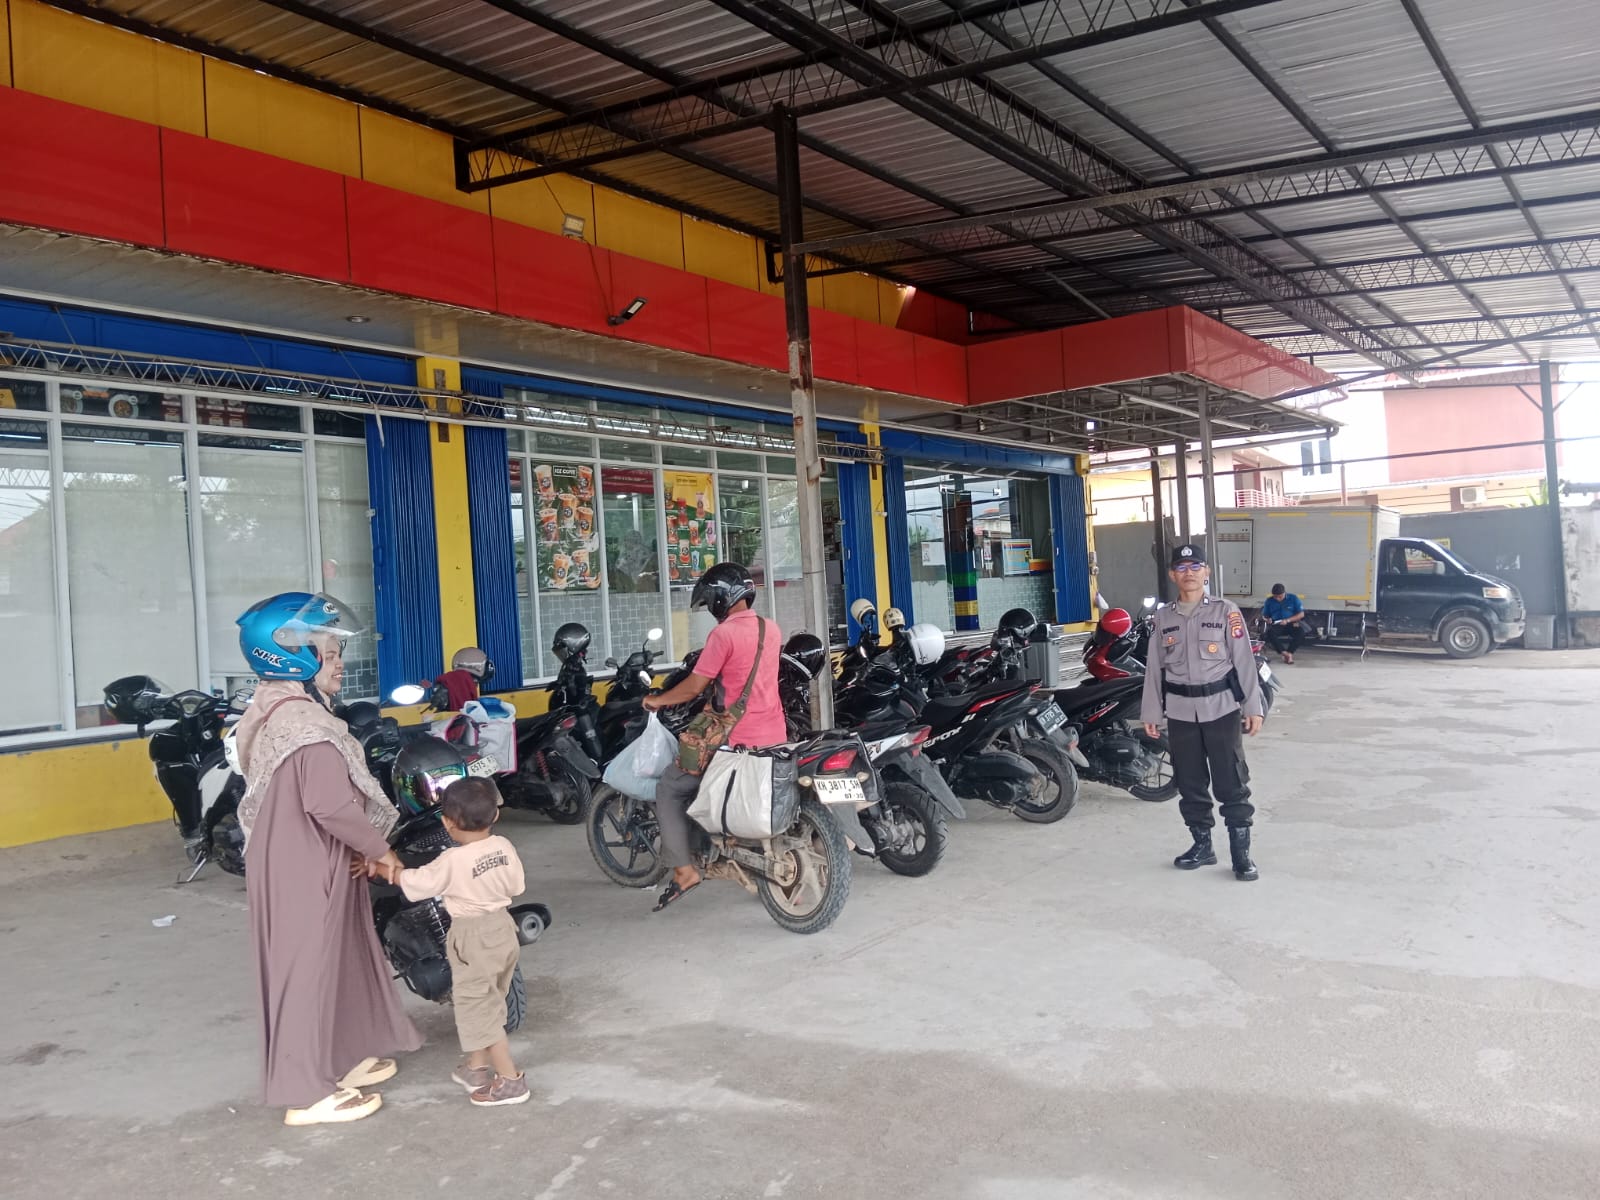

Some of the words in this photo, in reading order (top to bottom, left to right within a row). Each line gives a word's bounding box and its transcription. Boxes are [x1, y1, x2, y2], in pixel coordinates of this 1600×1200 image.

[252, 647, 287, 667] NHK
[816, 780, 828, 791] KH
[828, 779, 847, 791] 3817
